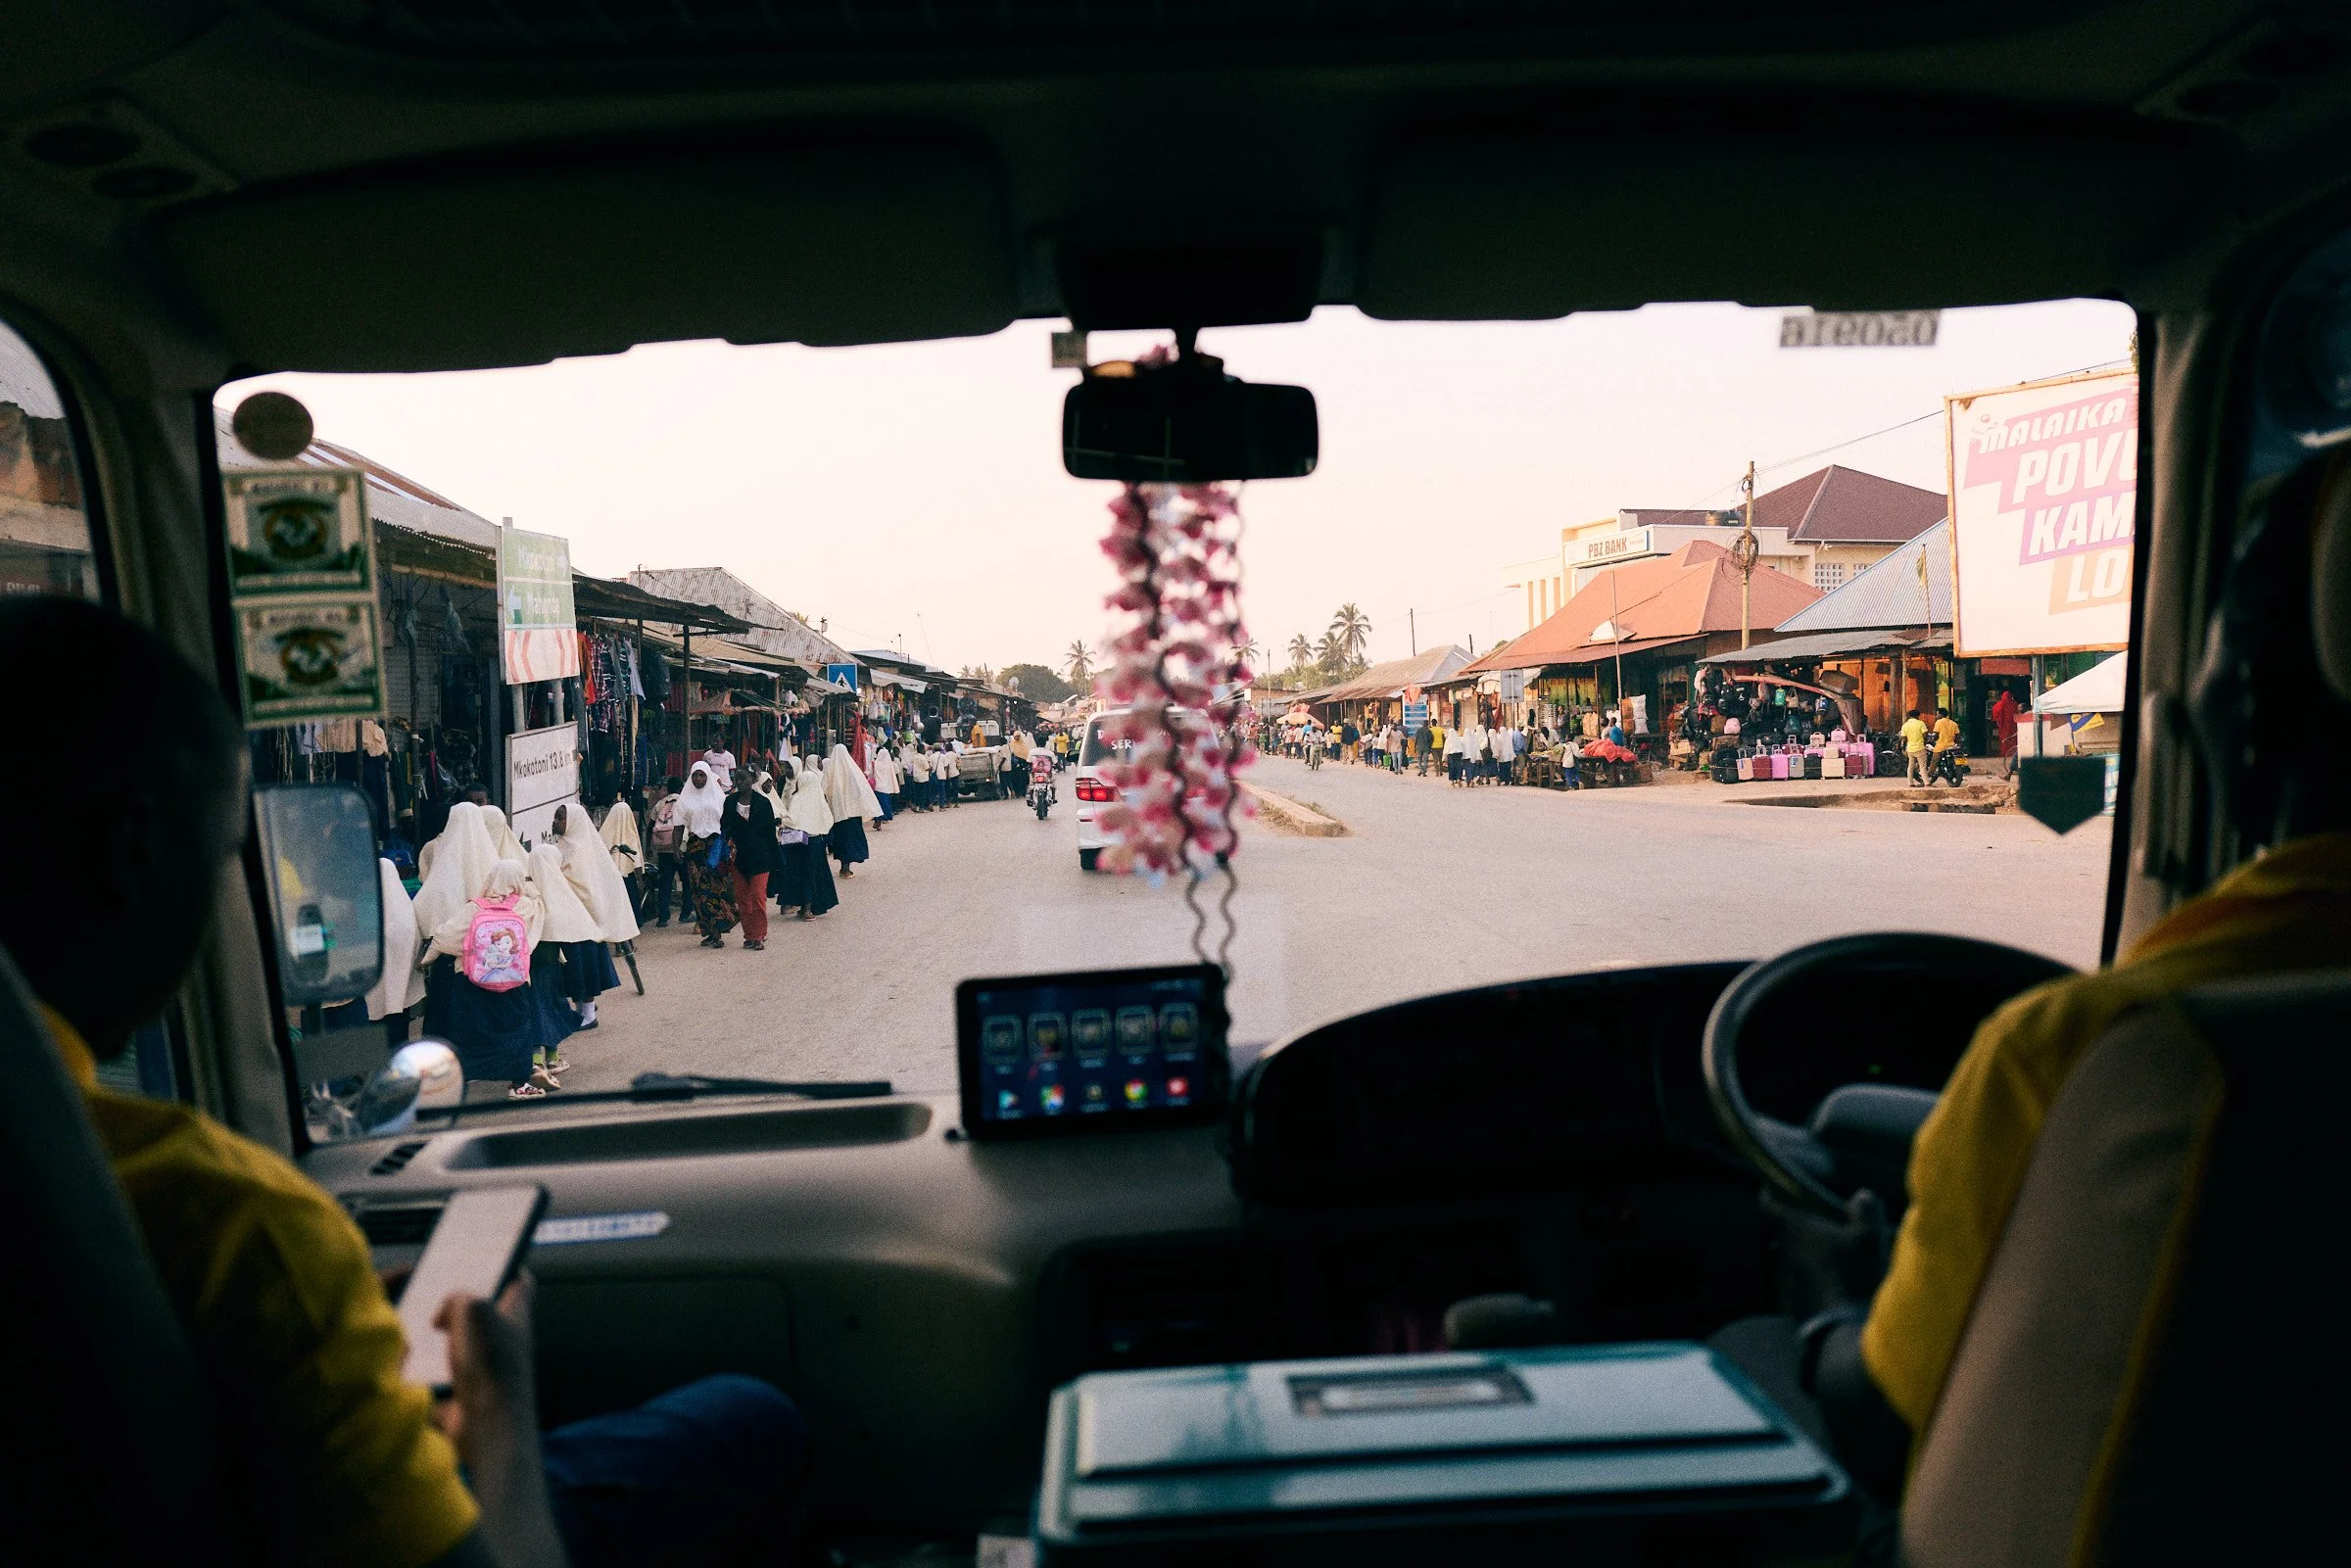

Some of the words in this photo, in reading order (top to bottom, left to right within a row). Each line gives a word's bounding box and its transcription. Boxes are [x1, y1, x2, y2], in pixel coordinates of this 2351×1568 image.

[2028, 492, 2135, 556] KAM
[1588, 542, 1604, 559] PBZ
[1605, 537, 1628, 555] BANK
[1111, 738, 1132, 750] SER
[513, 753, 549, 780] Mkokotoni
